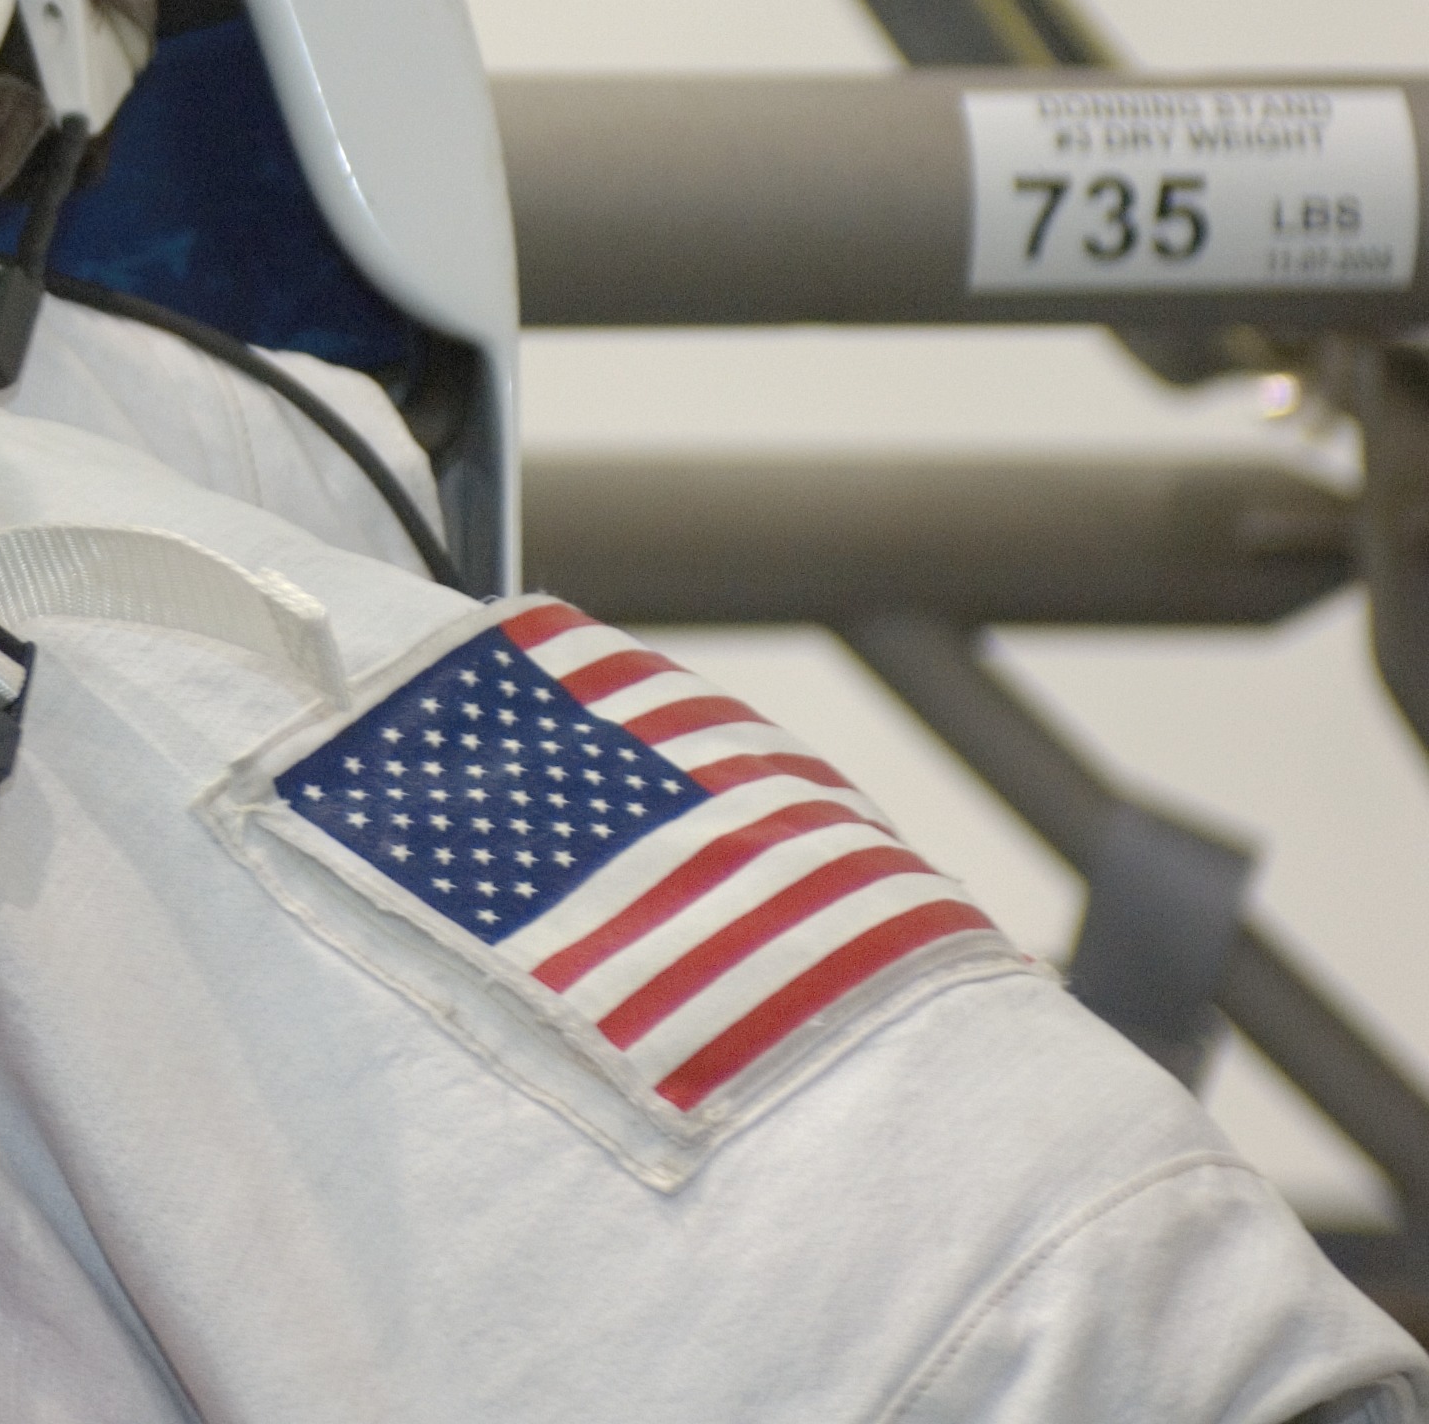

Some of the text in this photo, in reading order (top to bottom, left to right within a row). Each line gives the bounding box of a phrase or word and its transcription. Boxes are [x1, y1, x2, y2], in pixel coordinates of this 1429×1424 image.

[1038, 91, 1333, 120] DONNING STAND
[1103, 124, 1176, 154] DRY
[1186, 122, 1328, 154] WEIGHT
[1013, 174, 1360, 262] 735 LBS
